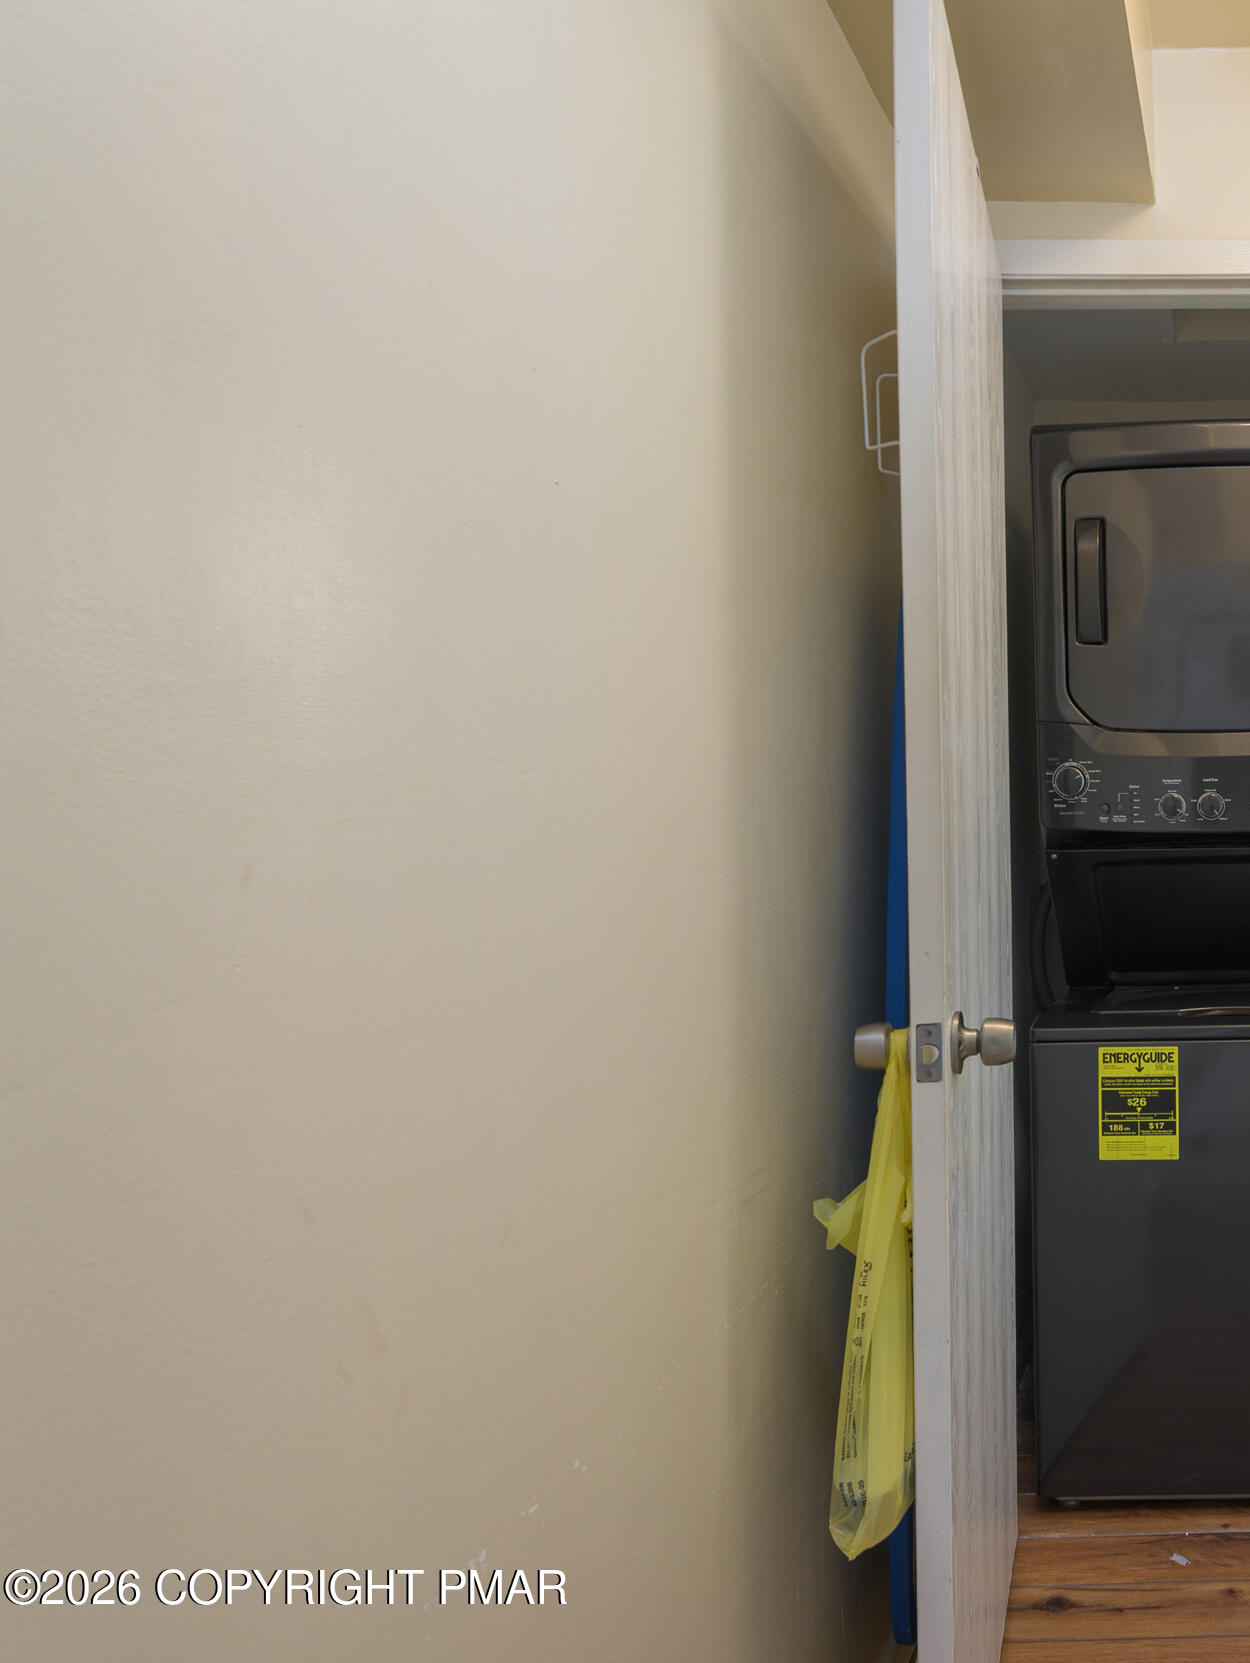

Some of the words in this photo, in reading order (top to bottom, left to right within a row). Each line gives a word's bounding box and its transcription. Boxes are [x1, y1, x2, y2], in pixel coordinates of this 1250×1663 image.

[1102, 1052, 1175, 1064] ENERGYGUIDE
[1127, 1097, 1147, 1107] $26
[1148, 1122, 1165, 1130] $17
